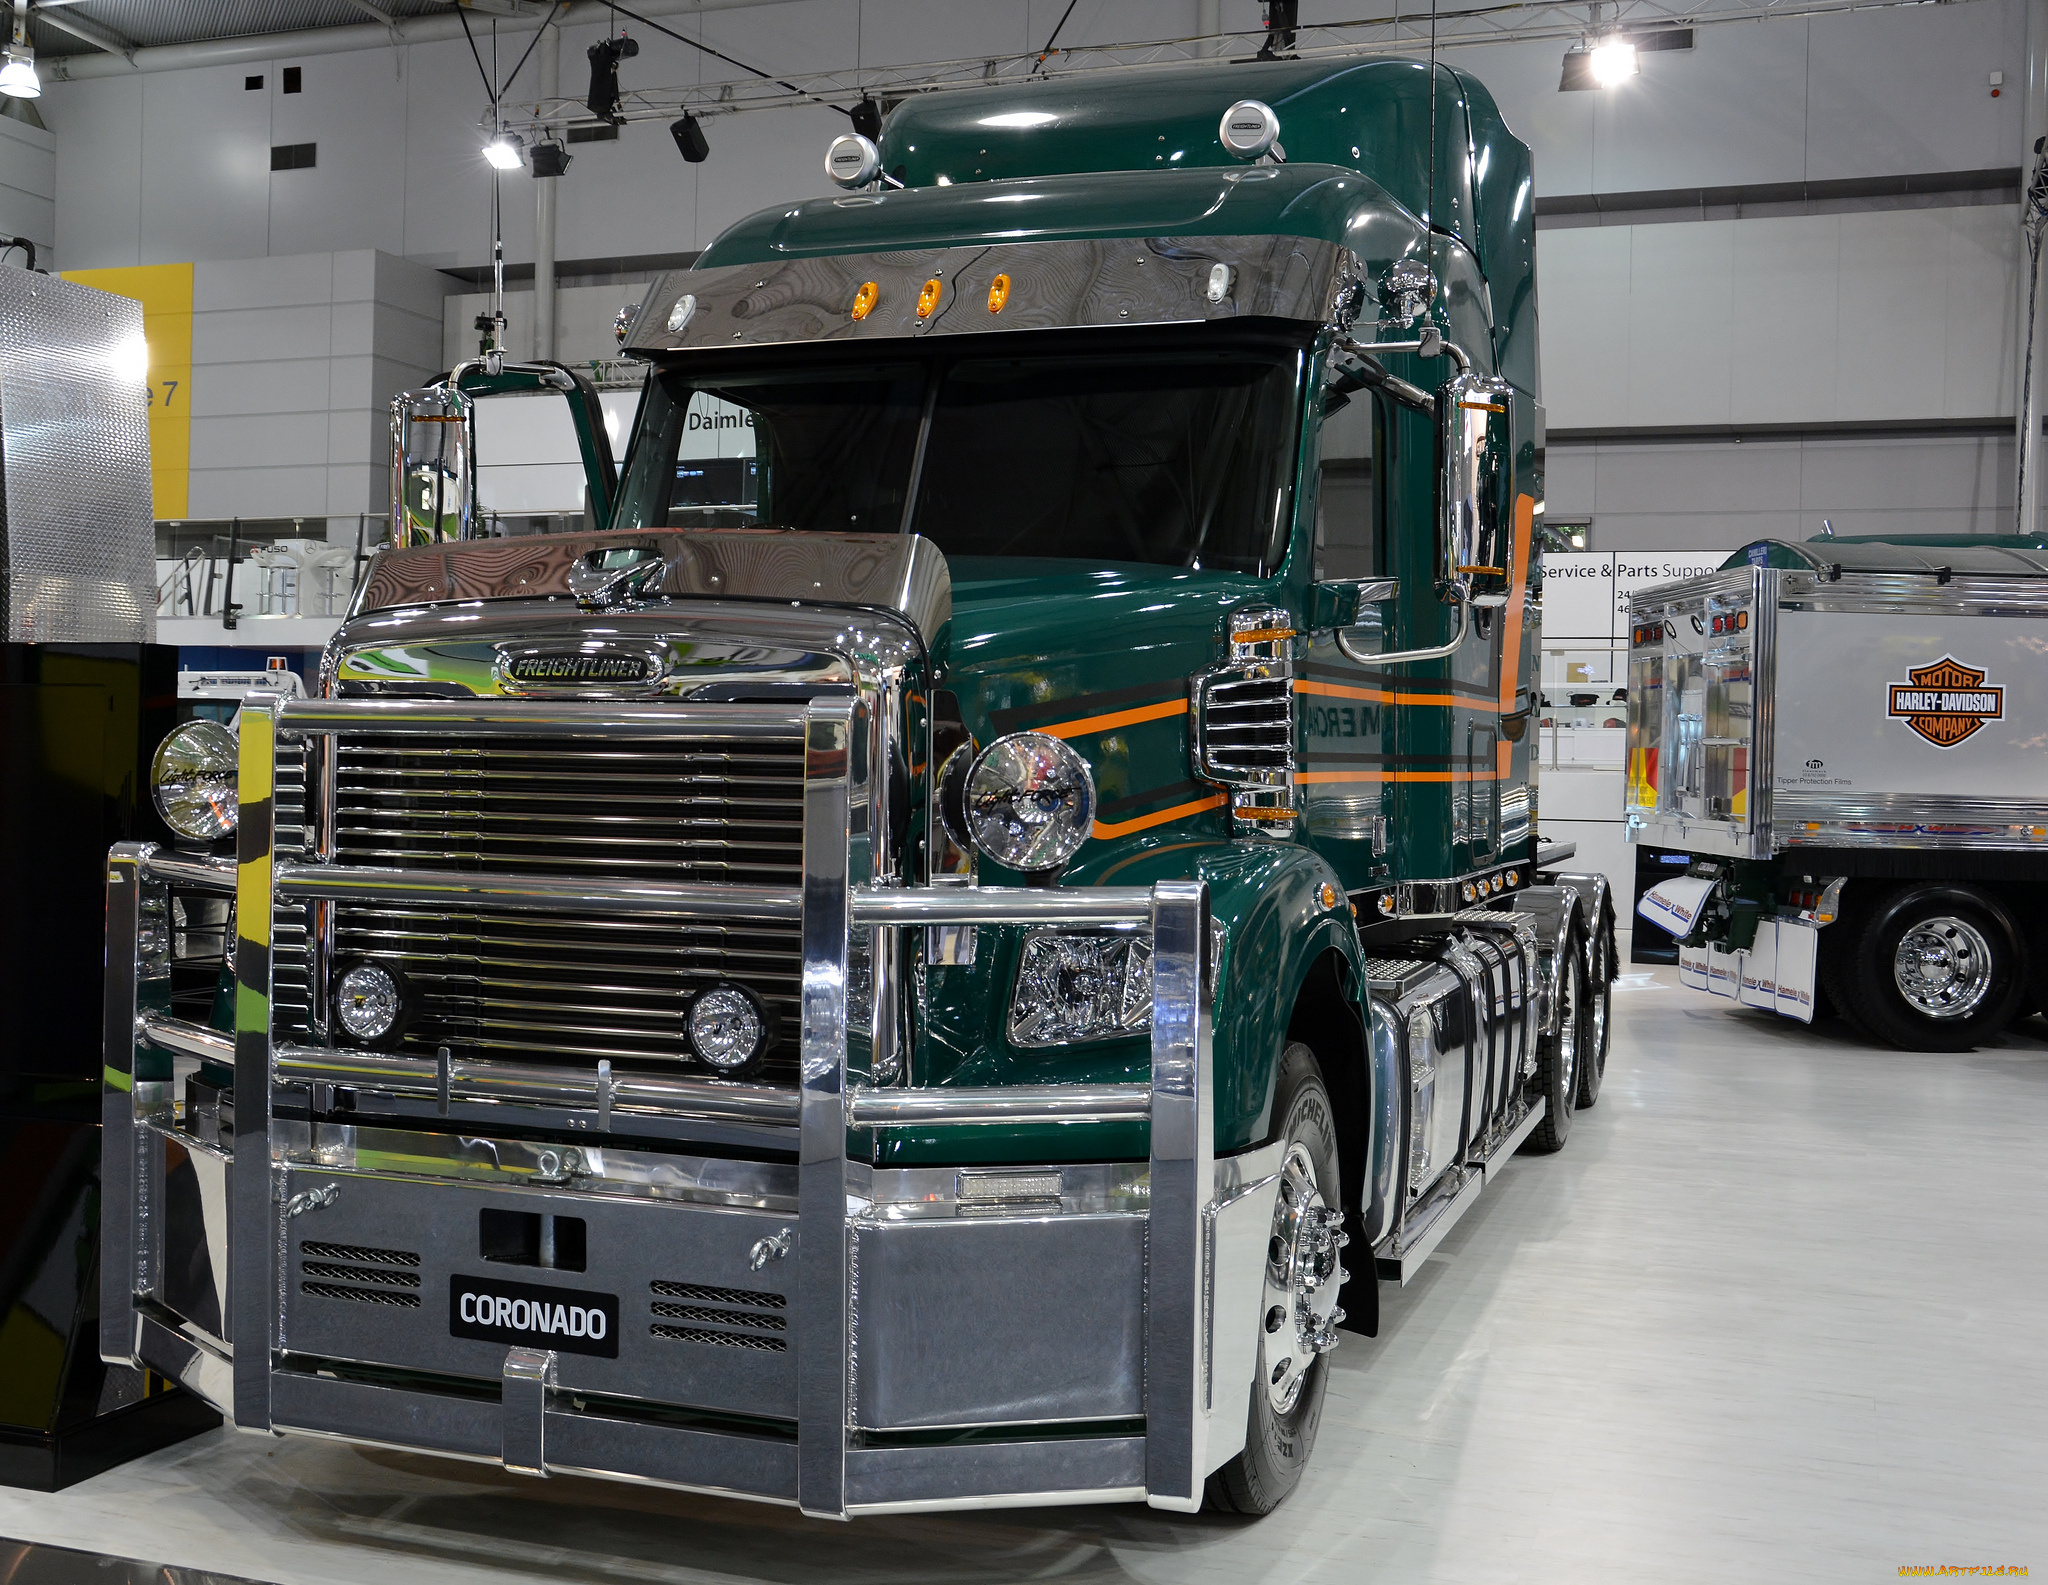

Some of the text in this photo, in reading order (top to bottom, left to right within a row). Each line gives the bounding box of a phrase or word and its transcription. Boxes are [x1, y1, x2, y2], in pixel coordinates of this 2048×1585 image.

[162, 381, 178, 406] 7
[689, 409, 754, 430] Daimle
[1600, 563, 1612, 577] &
[1617, 564, 1658, 578] Parts
[1662, 563, 1718, 580] Suppo
[515, 657, 642, 677] FREIGHTLINER
[1920, 666, 1974, 687] MOTOR
[1896, 691, 1996, 712] HARLEY-DAVIDSON
[1918, 716, 1973, 741] COMPANY
[1777, 776, 1798, 784] Tipper
[1799, 777, 1833, 785] Protection
[460, 1292, 607, 1340] CORONADO
